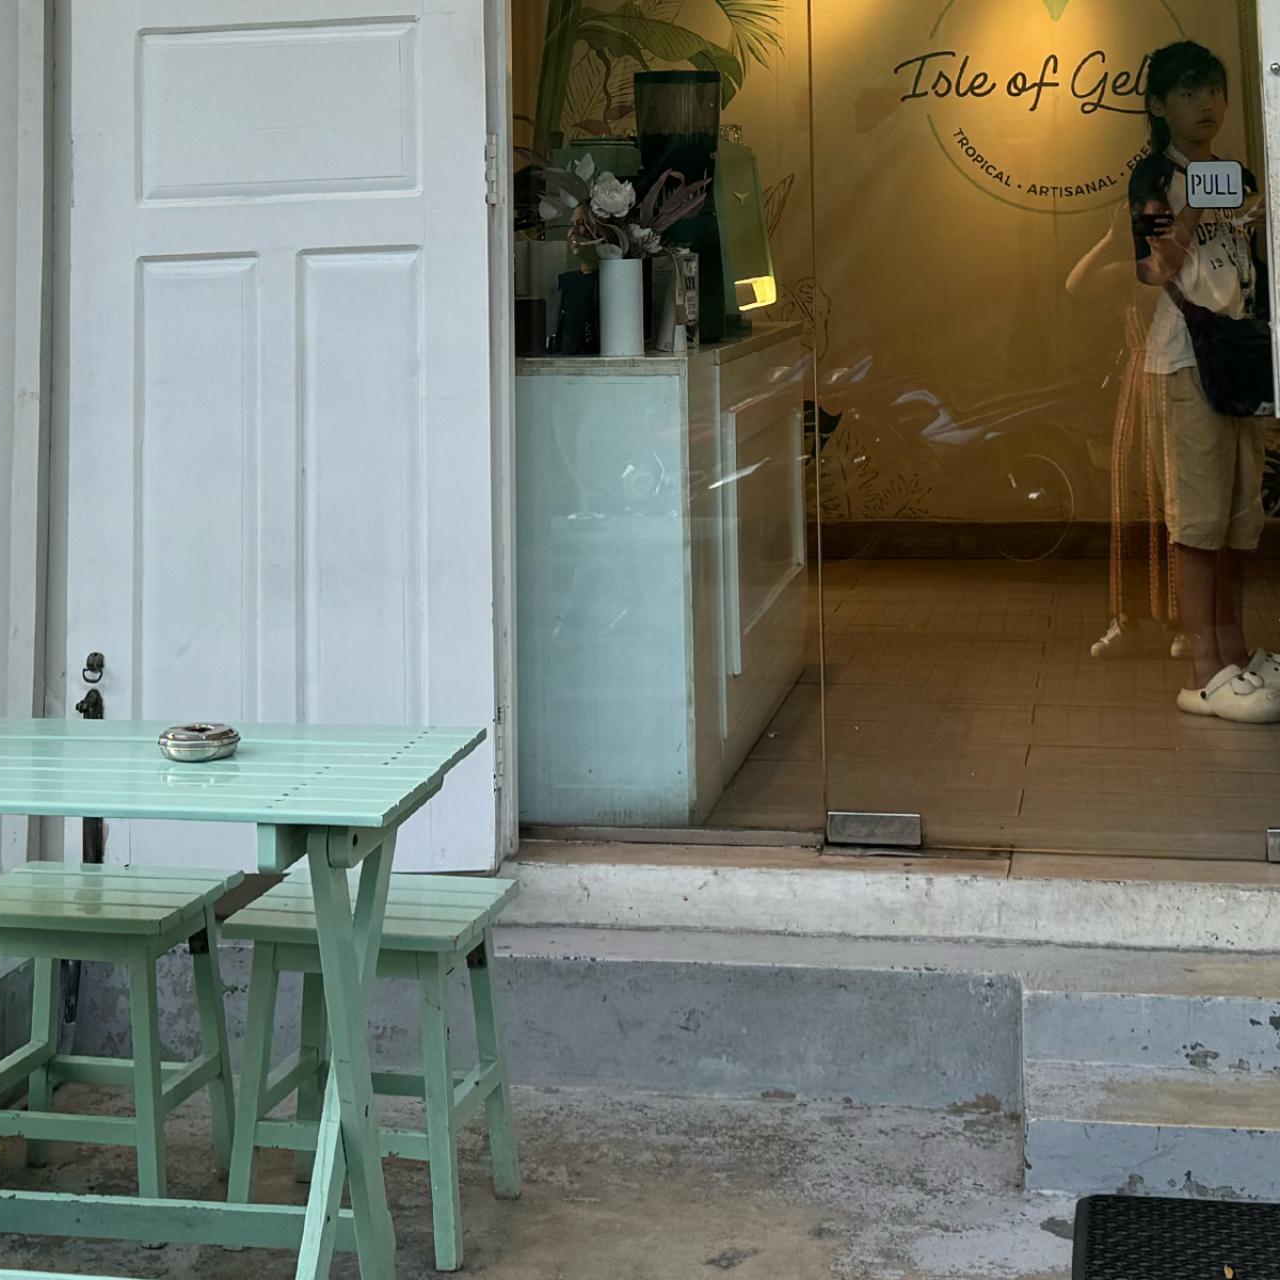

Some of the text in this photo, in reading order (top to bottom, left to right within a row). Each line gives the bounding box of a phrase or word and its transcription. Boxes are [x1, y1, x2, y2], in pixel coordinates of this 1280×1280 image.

[894, 50, 1150, 114] Isle of Gel
[953, 127, 1014, 189] TROPICAL
[1027, 175, 1118, 198] ARTISANAL
[1190, 173, 1238, 196] PULL
